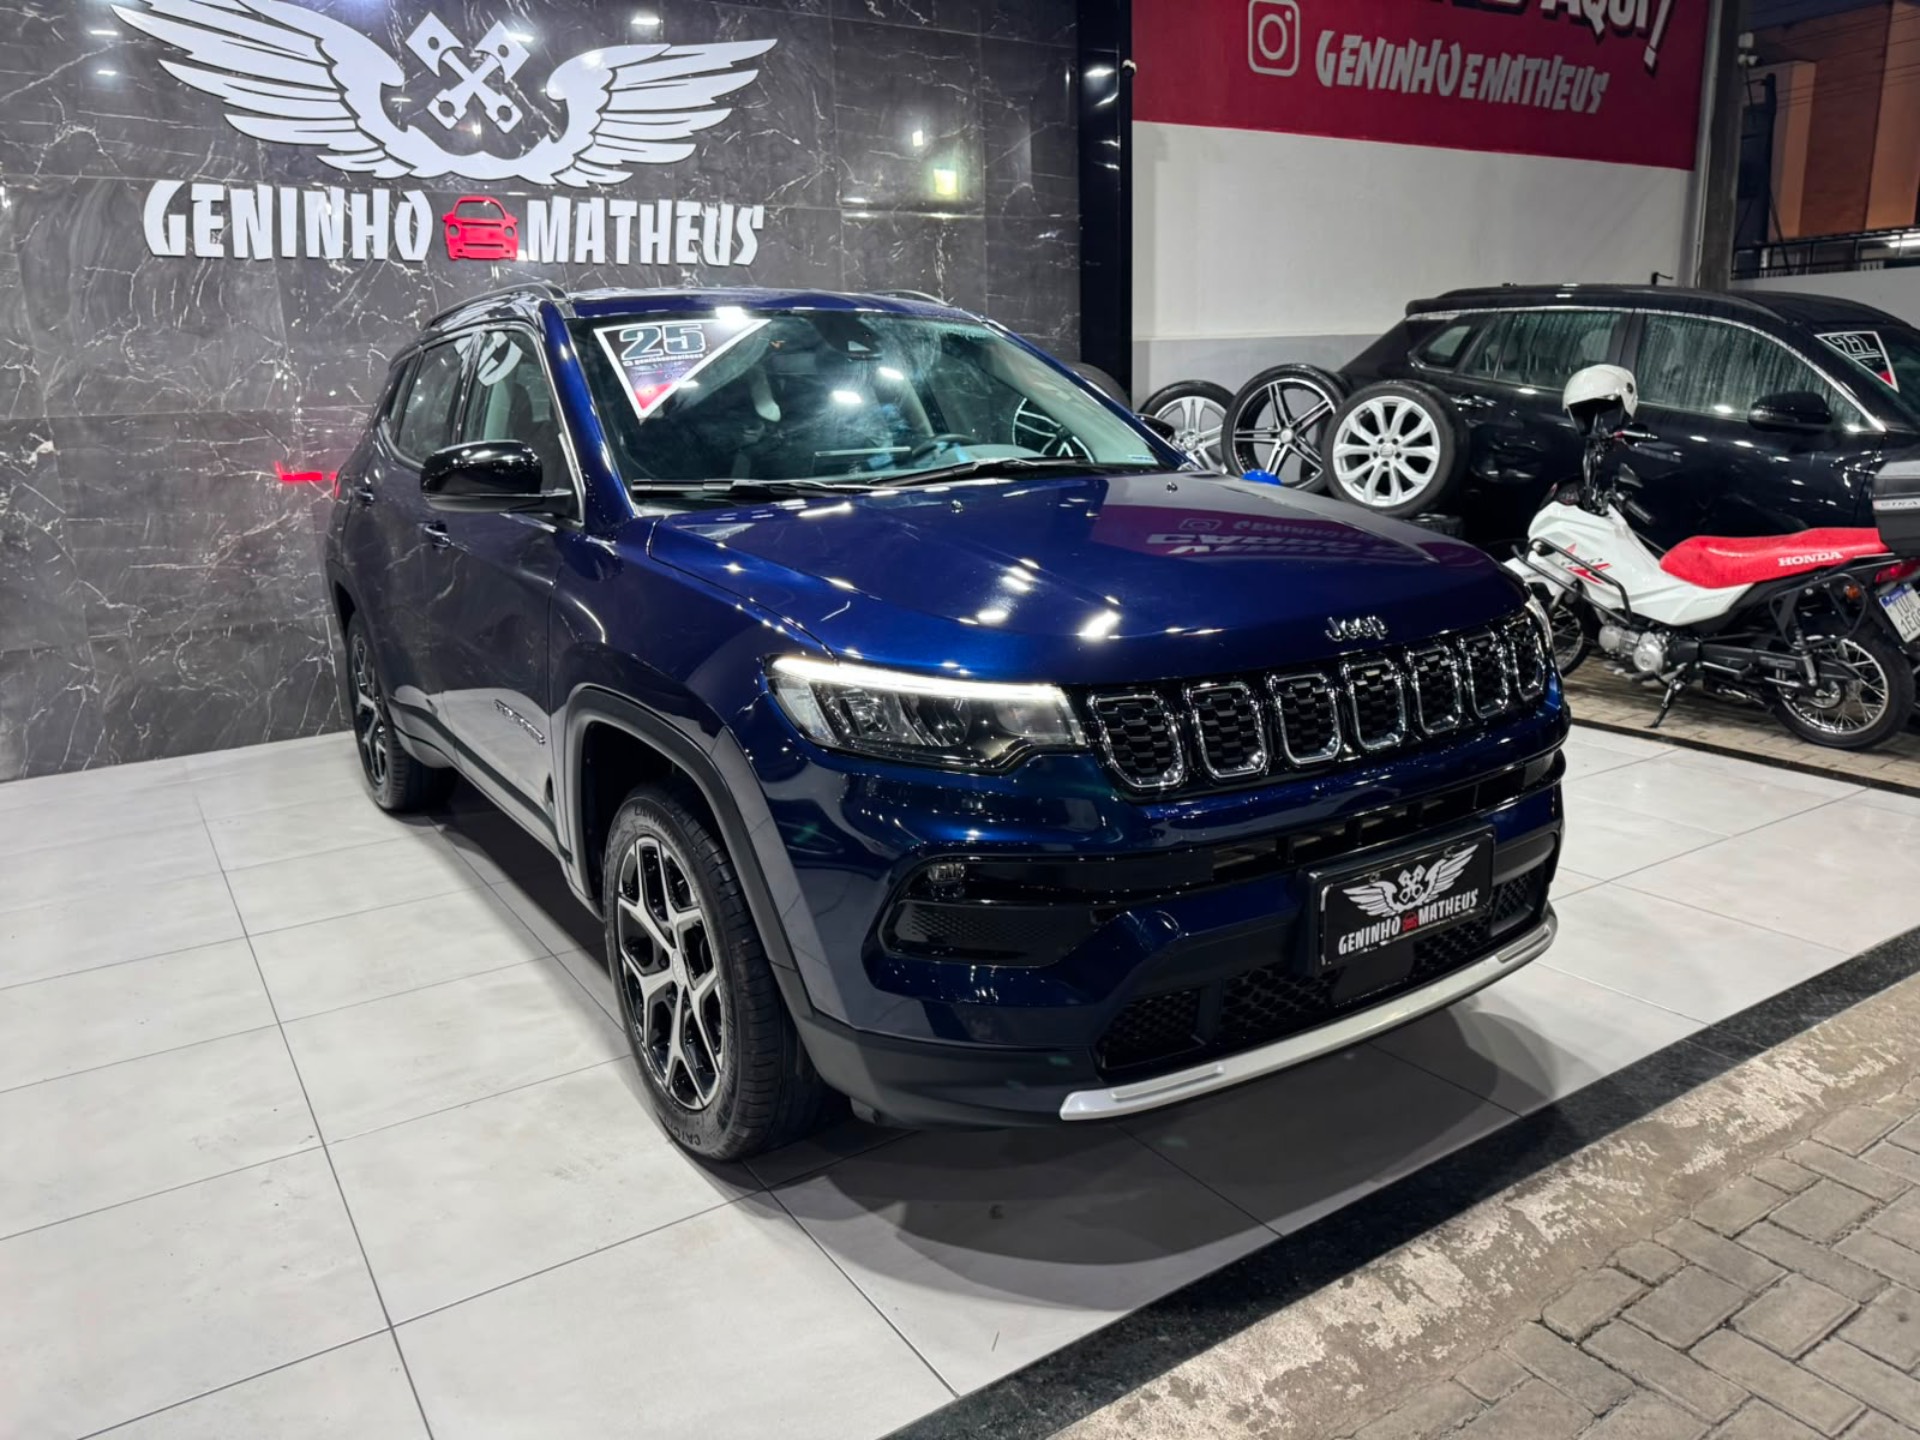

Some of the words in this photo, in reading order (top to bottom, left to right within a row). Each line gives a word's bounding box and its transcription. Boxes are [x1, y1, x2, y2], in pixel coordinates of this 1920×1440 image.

[144, 180, 433, 262] GENINHO
[525, 196, 764, 266] MATHEUS
[619, 324, 706, 360] 25
[1778, 550, 1843, 567] HONDA
[1324, 615, 1389, 642] Jeep
[1338, 914, 1401, 955] GENINHO
[1418, 888, 1479, 925] MATHEUS
